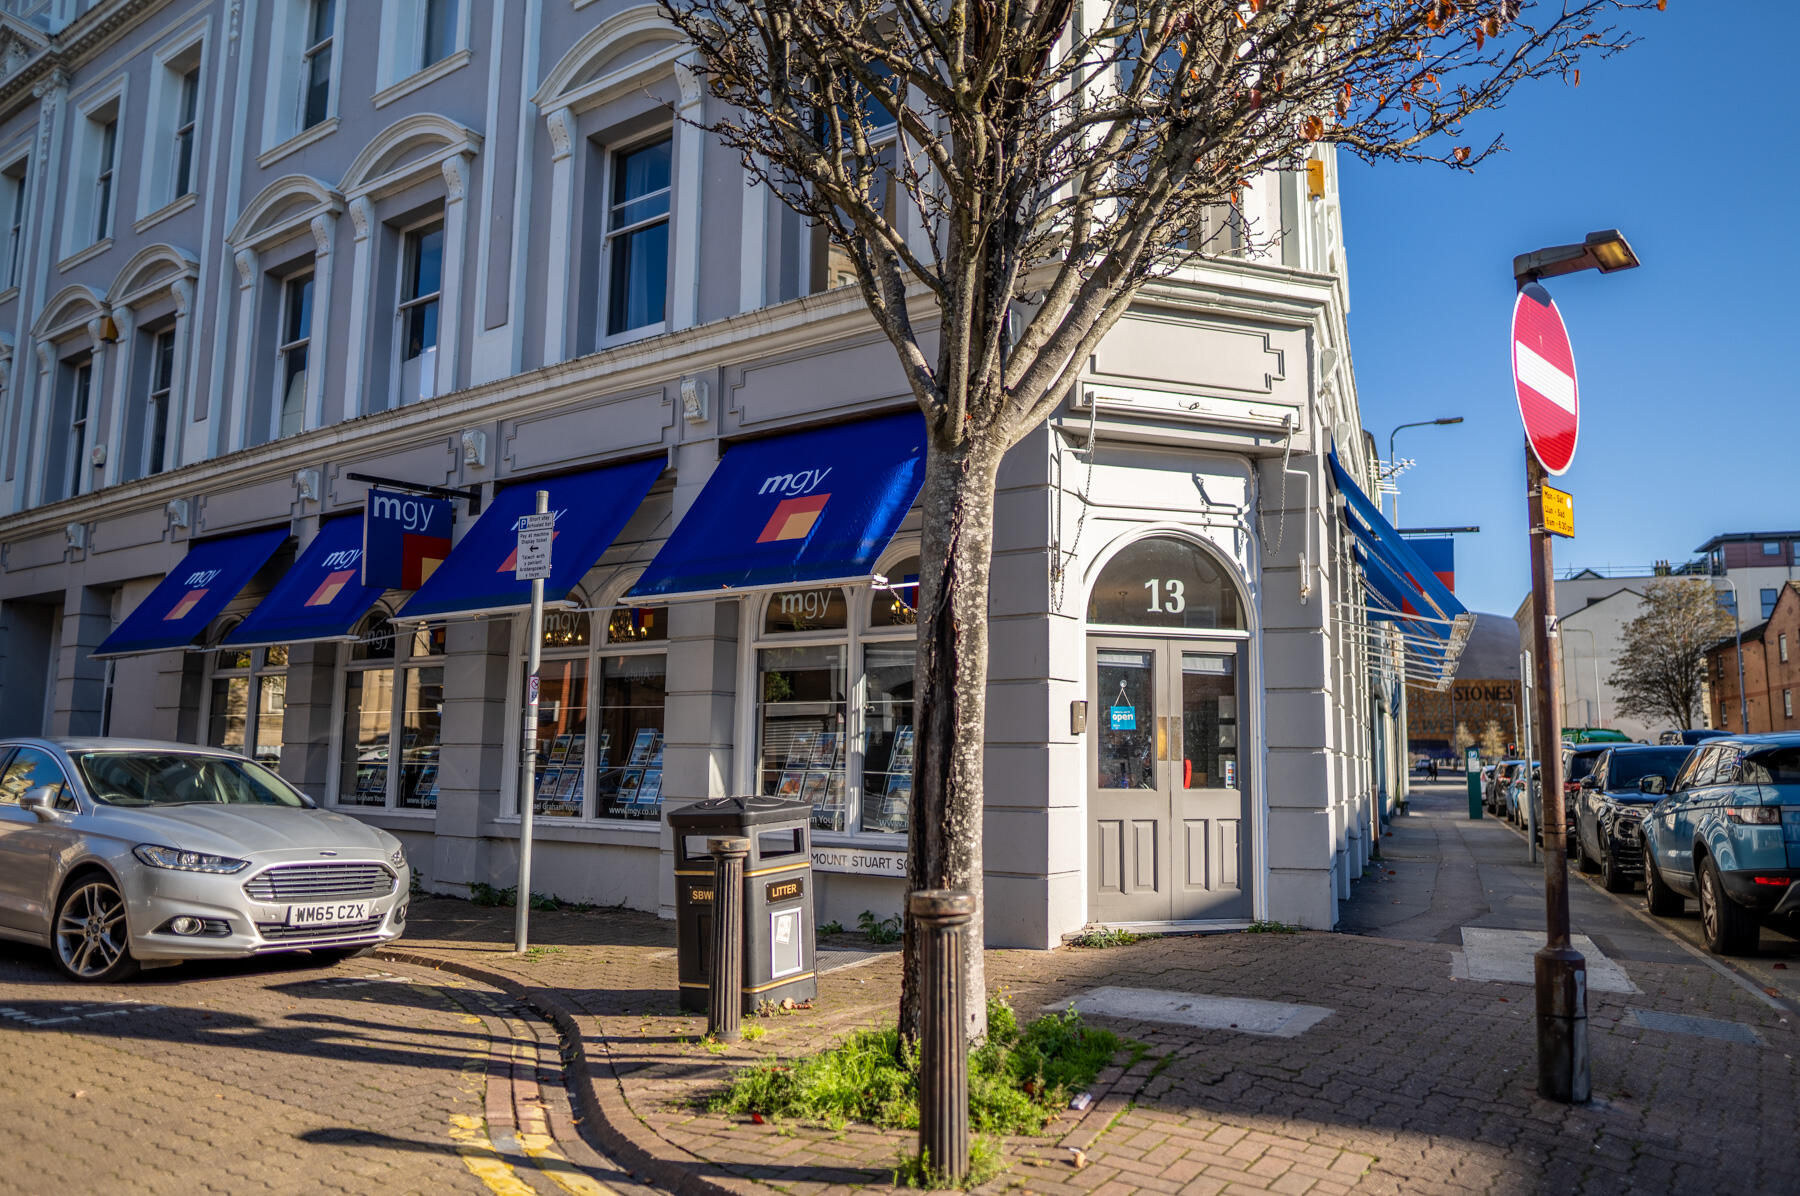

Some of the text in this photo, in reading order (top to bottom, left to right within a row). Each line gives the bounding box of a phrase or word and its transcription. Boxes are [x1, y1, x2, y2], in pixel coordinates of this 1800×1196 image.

[758, 466, 832, 496] mgy
[373, 495, 434, 532] mgy
[322, 548, 363, 570] mgy
[184, 569, 222, 588] mgy
[781, 591, 831, 620] mgy
[1144, 578, 1186, 614] 13
[543, 611, 581, 637] mgy
[1454, 686, 1515, 701] STONES
[1112, 714, 1134, 722] open
[609, 806, 658, 817] www.mgy.co.uk
[811, 853, 848, 866] MOUNT
[852, 855, 892, 870] STUART
[772, 883, 797, 898] LITTER
[296, 904, 364, 923] WM65 CZX
